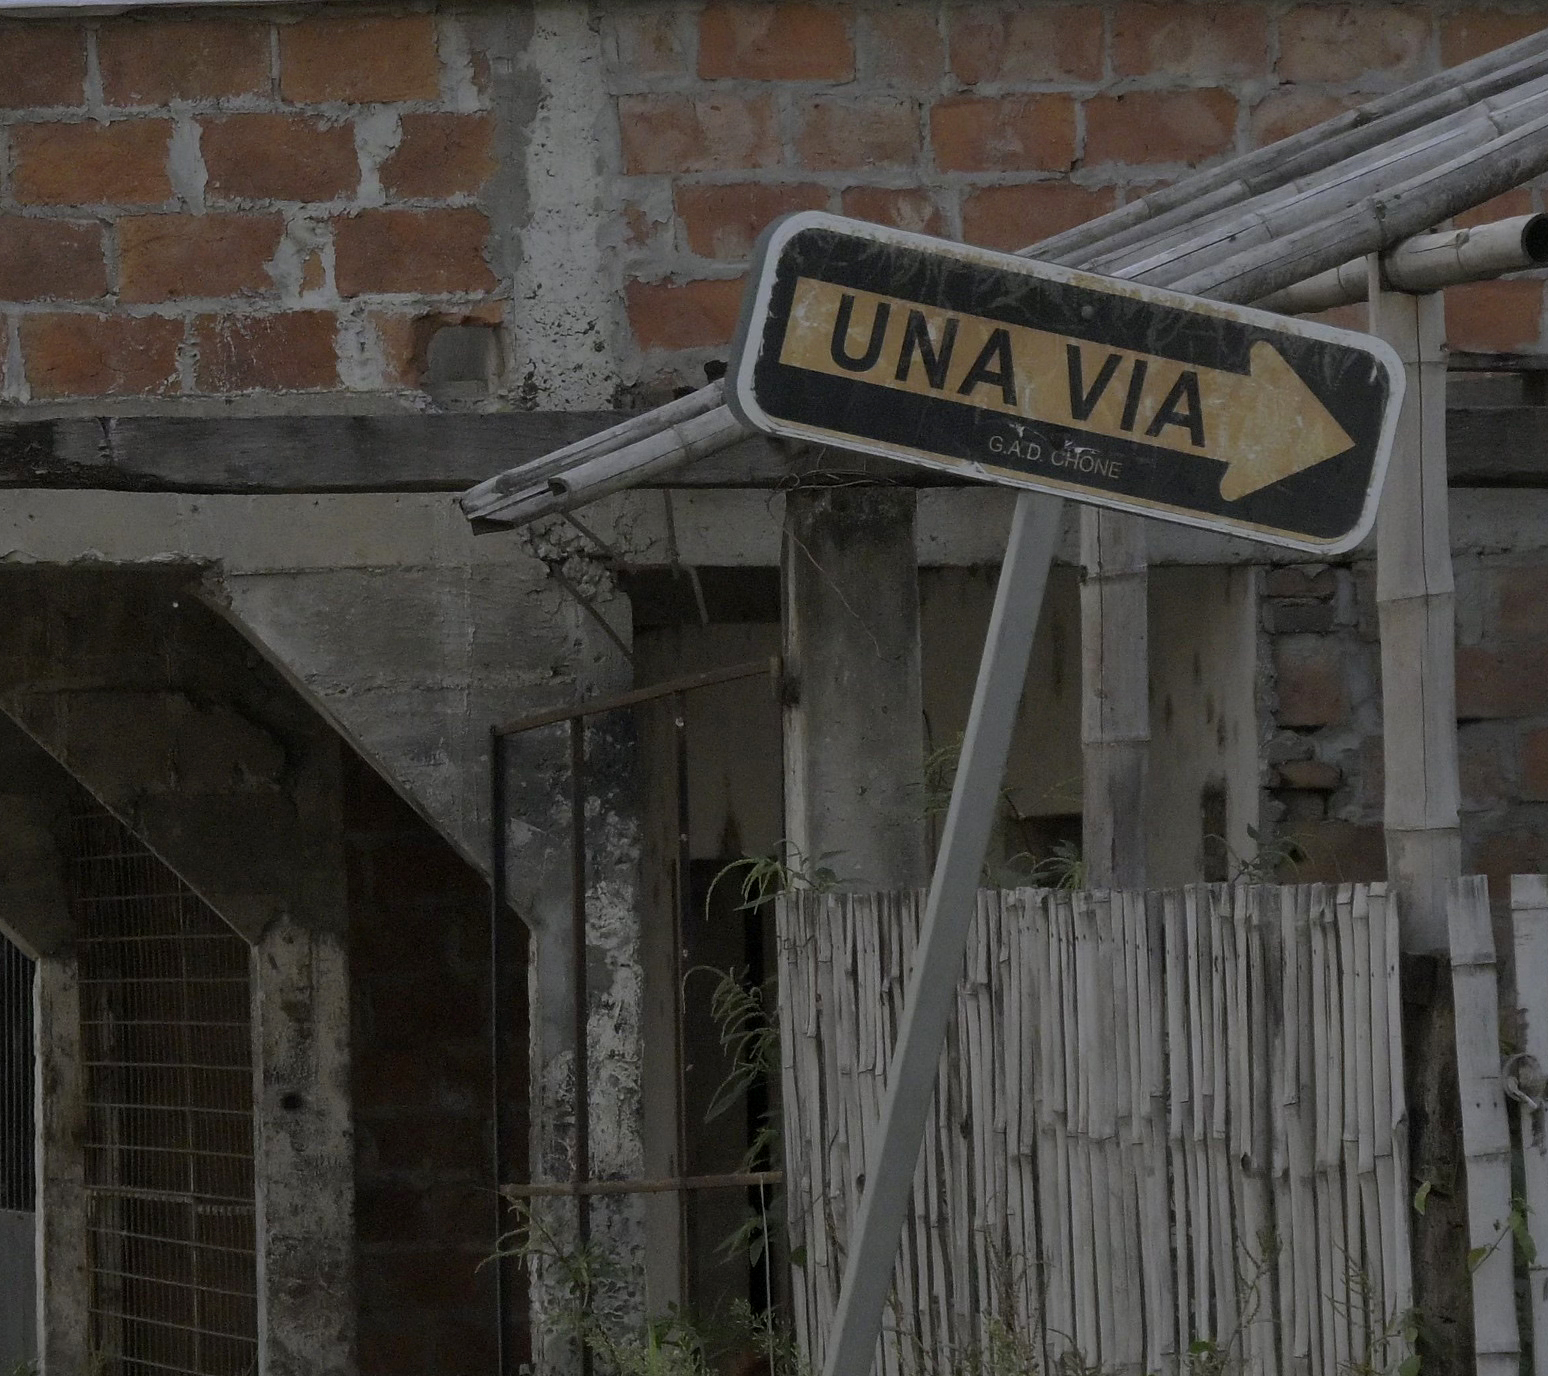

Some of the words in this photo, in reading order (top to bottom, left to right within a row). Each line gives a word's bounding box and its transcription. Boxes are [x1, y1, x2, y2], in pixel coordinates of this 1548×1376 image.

[829, 293, 1017, 408] UNA
[1065, 342, 1206, 448] VIA
[988, 432, 1045, 465] G.A.D.
[1050, 447, 1124, 482] CHONE
